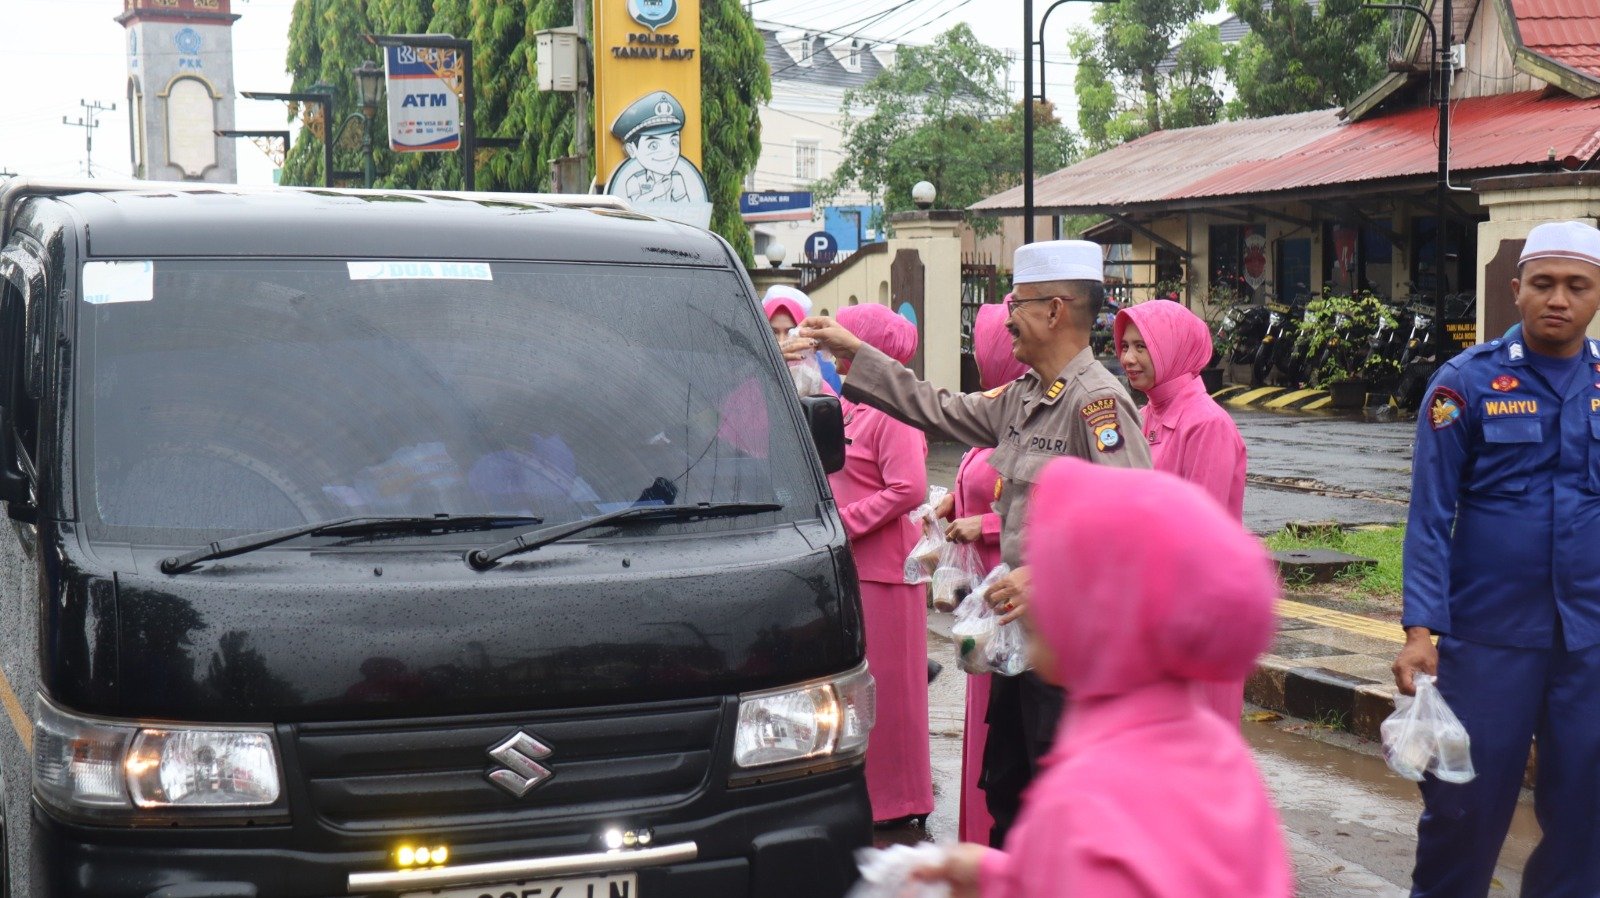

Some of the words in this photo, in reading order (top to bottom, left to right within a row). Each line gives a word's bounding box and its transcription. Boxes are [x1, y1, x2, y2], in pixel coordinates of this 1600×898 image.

[627, 33, 679, 45] POLRES
[611, 46, 657, 59] TANAH
[660, 48, 695, 60] LAUT
[179, 58, 202, 68] PKK
[401, 93, 447, 108] ATM
[759, 195, 777, 203] BANK
[779, 195, 790, 203] BRI
[813, 236, 829, 260] P
[389, 263, 434, 277] DUA
[441, 264, 489, 278] MAS
[1082, 399, 1115, 415] POLRES
[1485, 400, 1538, 416] WAHYU
[1031, 437, 1068, 453] POLRI
